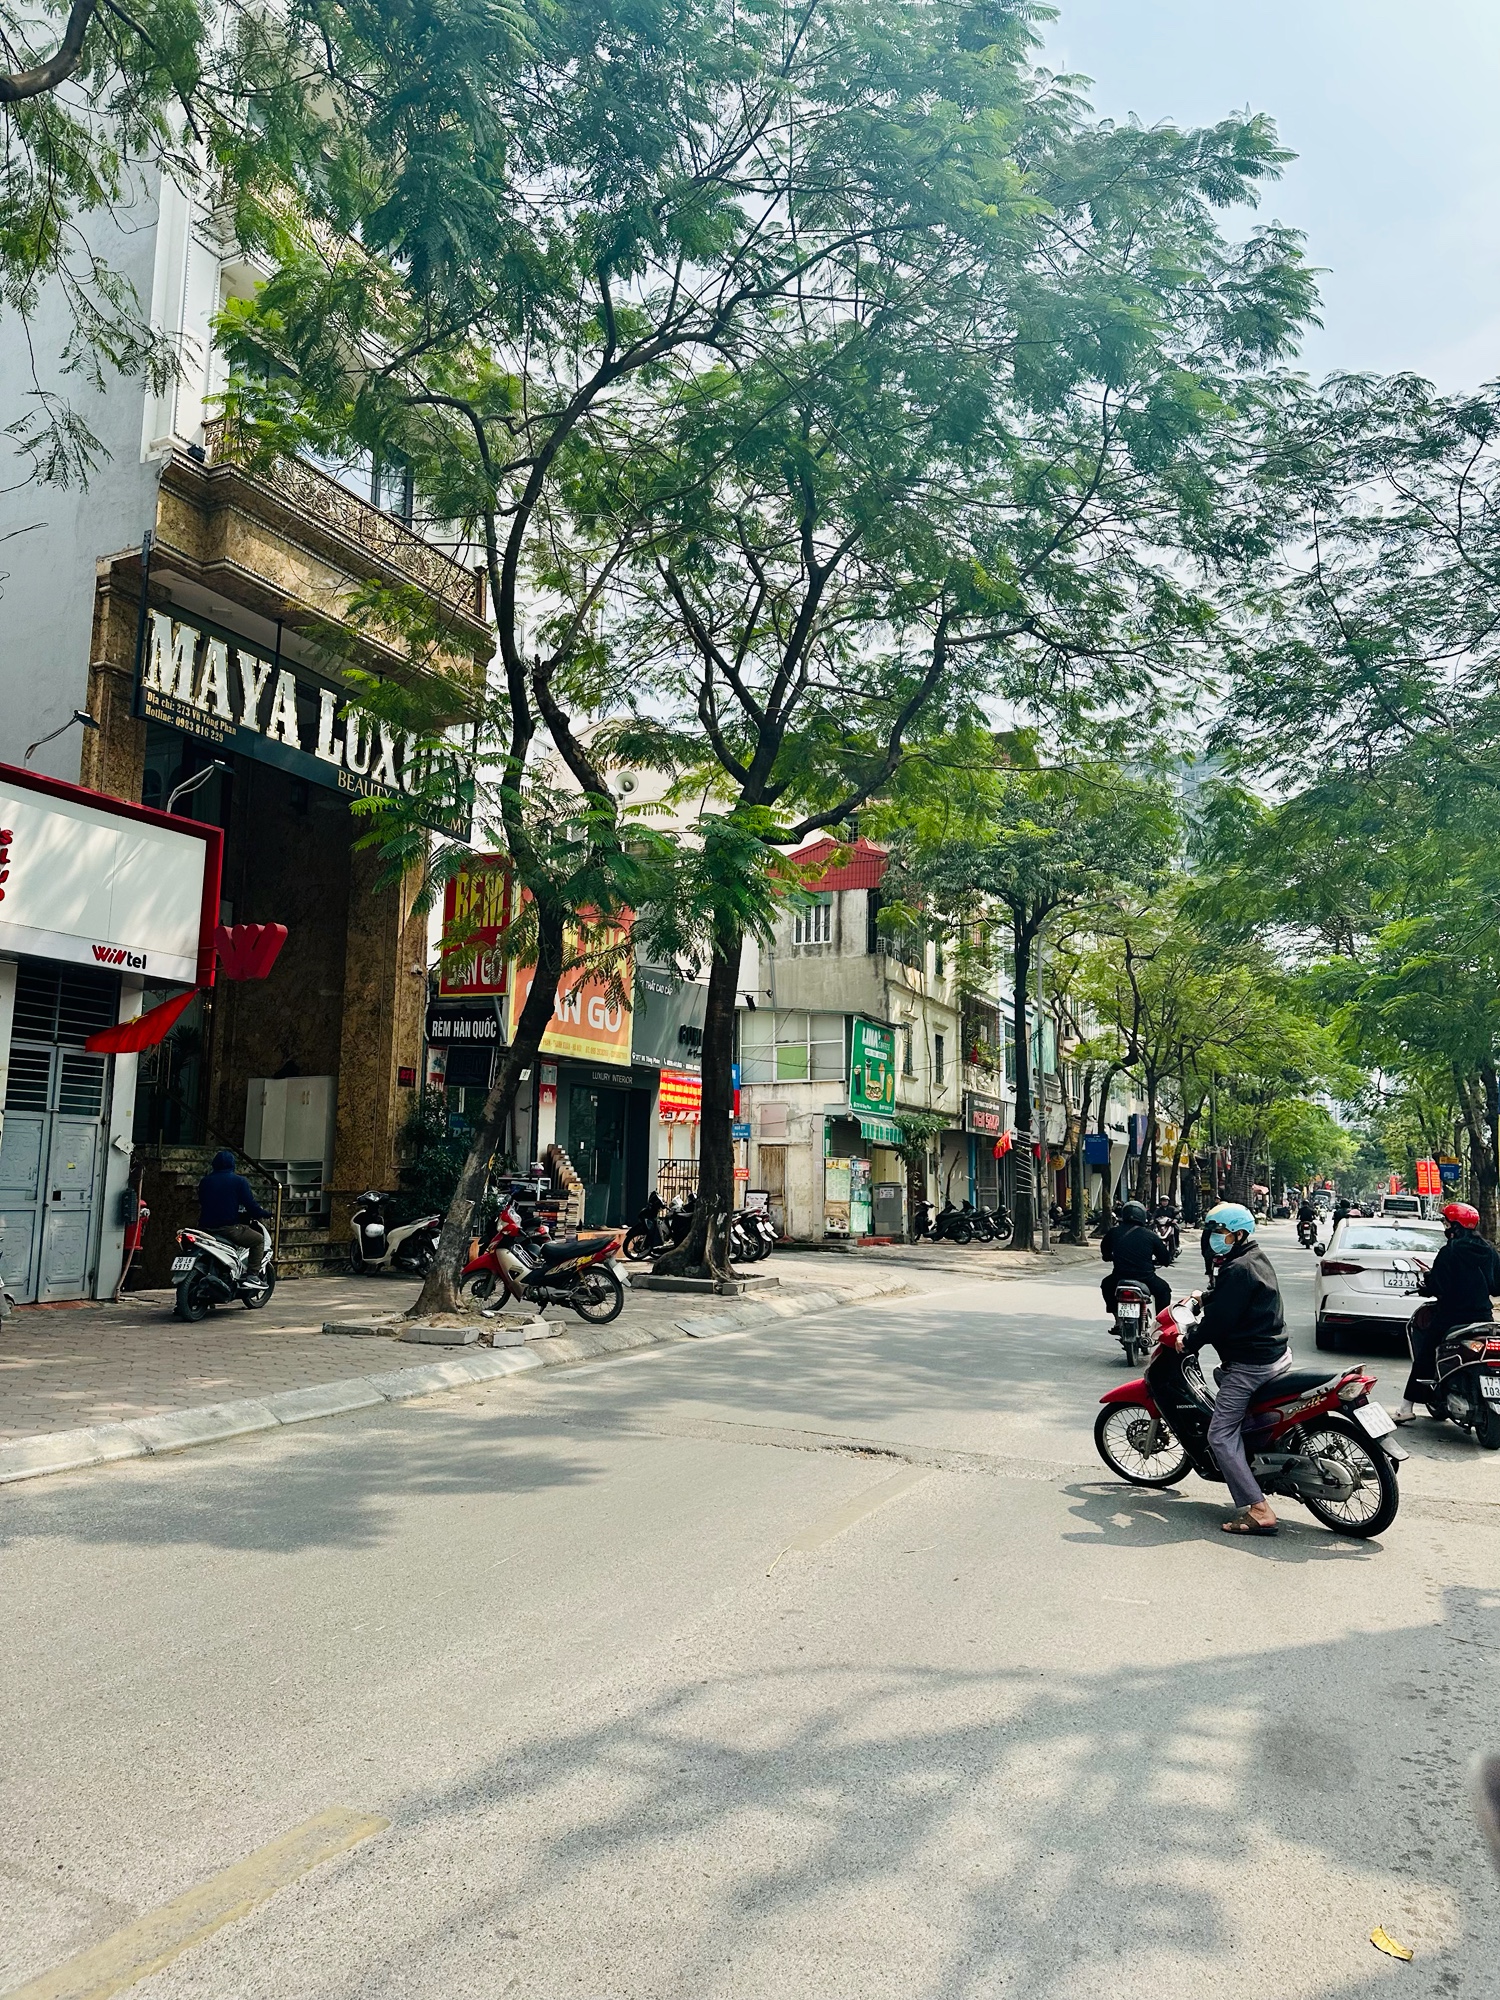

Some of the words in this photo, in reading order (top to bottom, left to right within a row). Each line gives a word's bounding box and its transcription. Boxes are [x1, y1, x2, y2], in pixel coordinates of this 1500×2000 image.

[140, 607, 301, 750] MAYA
[145, 704, 174, 724] Hotline:
[176, 703, 191, 717] 273
[432, 1016, 451, 1037] RÈM
[453, 1016, 471, 1038] HÀN
[472, 1015, 497, 1039] QUỐC
[592, 1071, 611, 1081] LUXURY
[612, 1074, 633, 1085] INTERIOR
